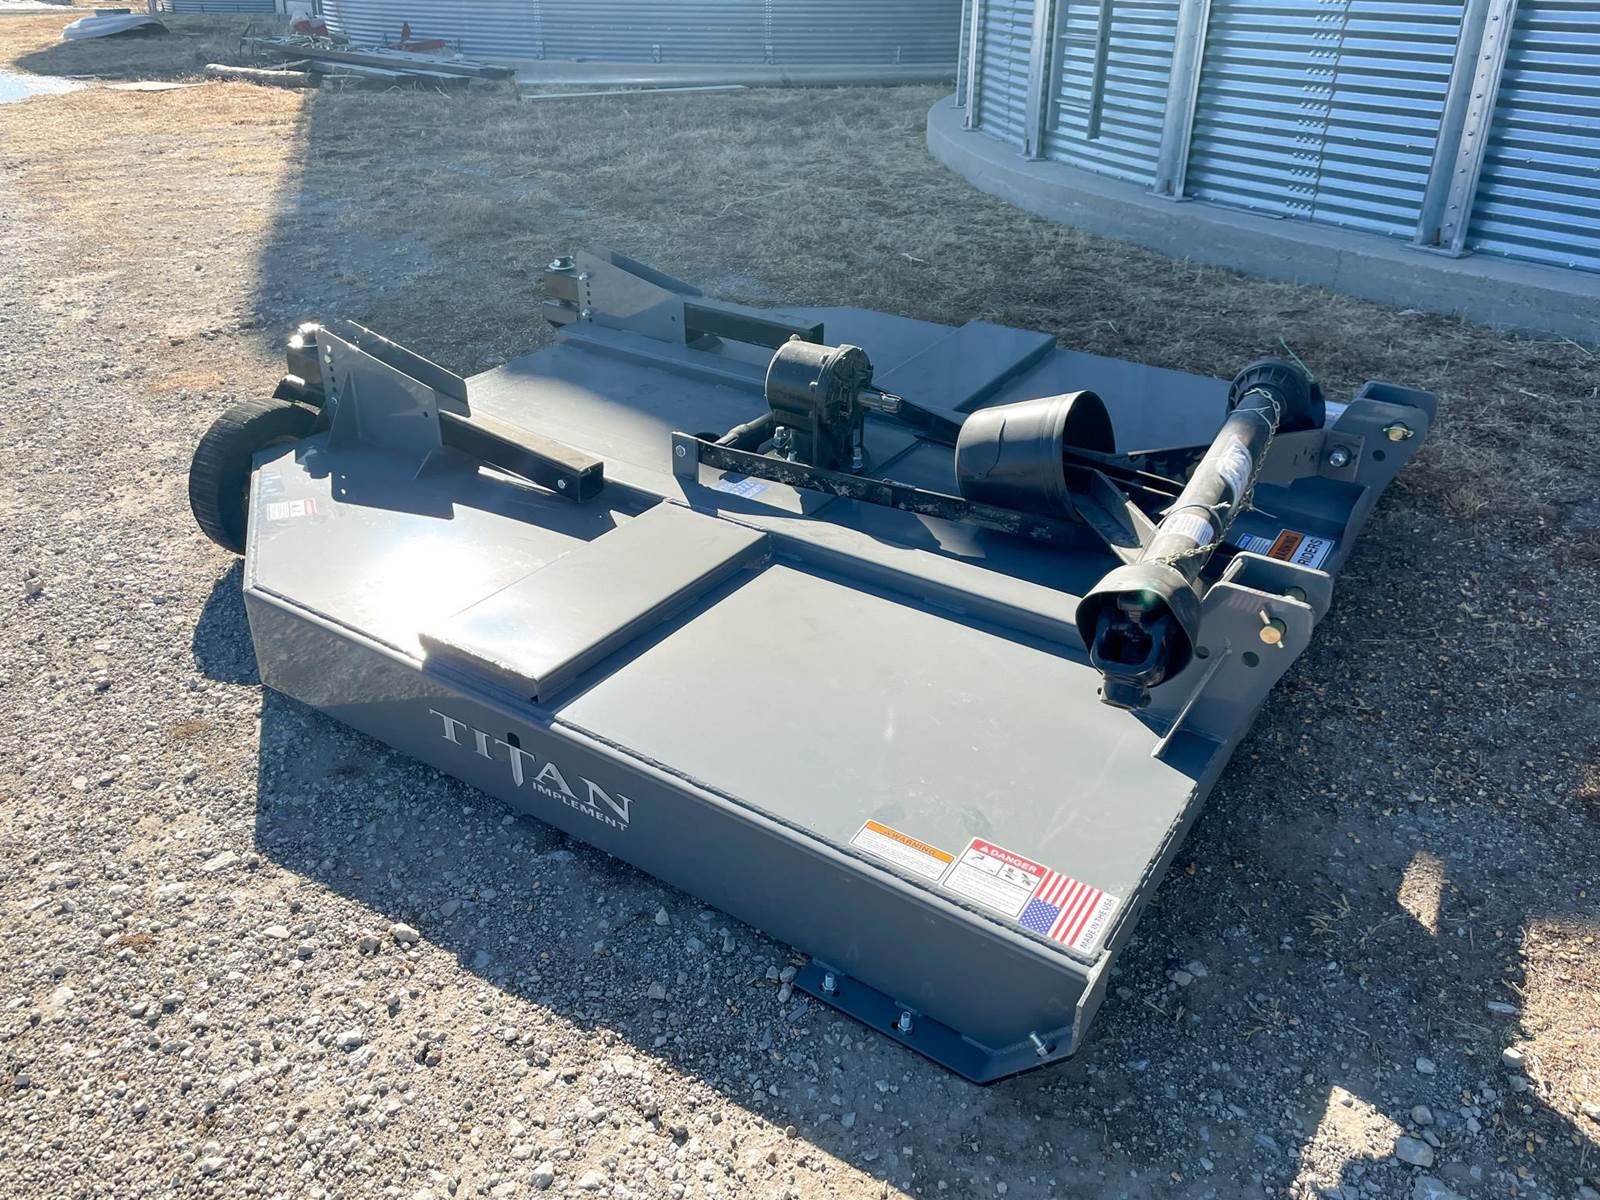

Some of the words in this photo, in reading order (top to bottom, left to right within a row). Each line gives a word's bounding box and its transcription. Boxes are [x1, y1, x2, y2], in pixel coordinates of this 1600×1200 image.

[1297, 538, 1324, 565] RIDERS
[429, 708, 635, 824] TITAN
[532, 782, 628, 831] IMPLEMENT
[891, 831, 937, 856] WARNING
[989, 849, 1037, 873] DANGER
[1080, 929, 1096, 949] MADE
[1095, 910, 1106, 922] THE
[1103, 899, 1114, 910] USA
